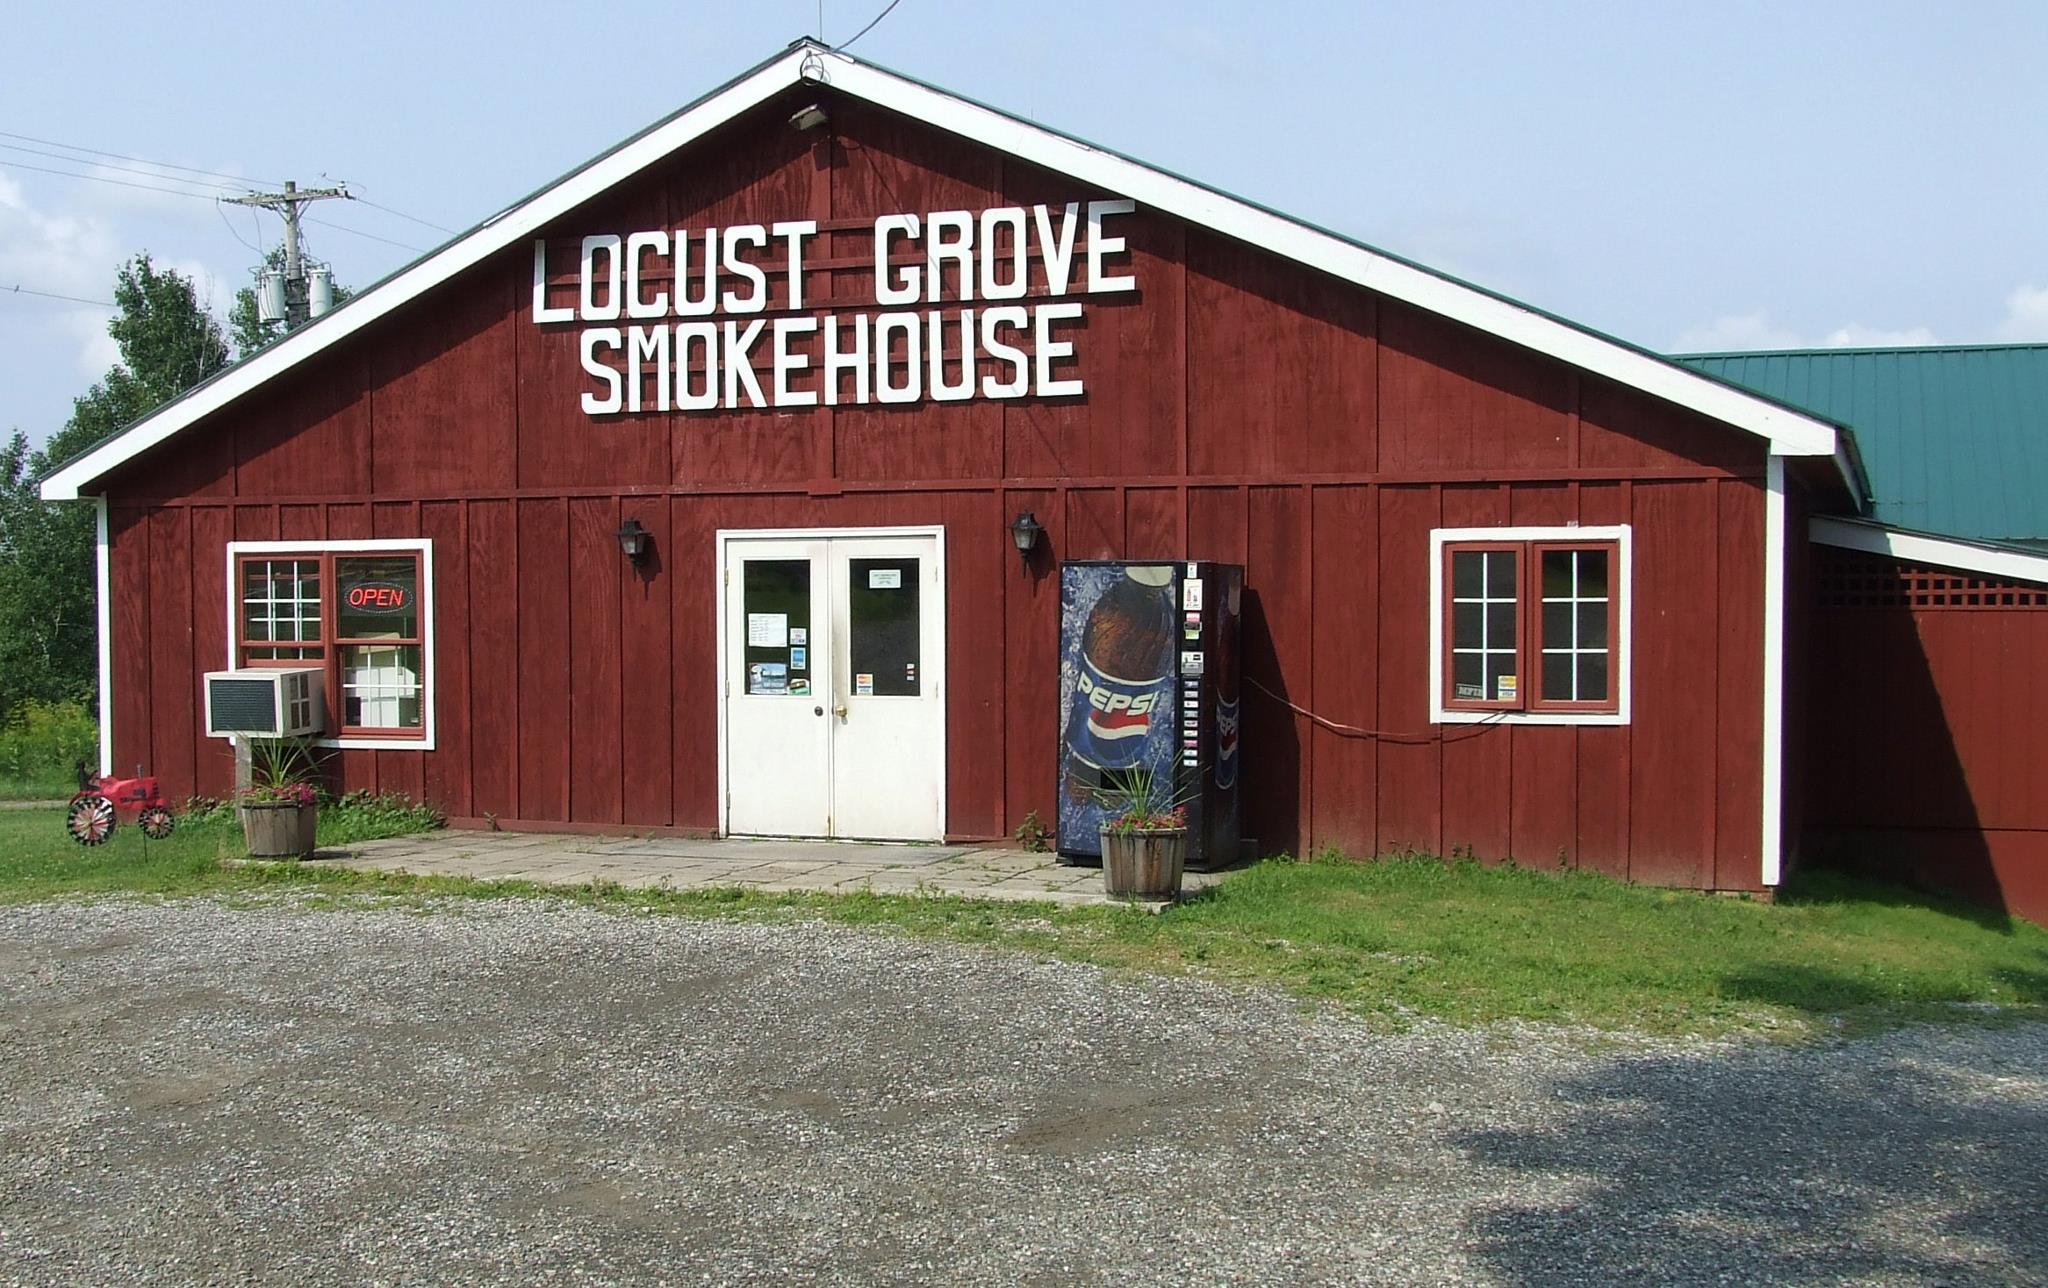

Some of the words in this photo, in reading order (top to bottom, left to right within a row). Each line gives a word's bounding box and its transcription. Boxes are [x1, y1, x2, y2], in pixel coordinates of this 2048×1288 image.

[533, 220, 817, 324] LOCUST
[874, 201, 1136, 306] GROVE
[580, 303, 1083, 415] SMOKEHOUSE
[349, 588, 404, 606] OPEN
[1077, 671, 1159, 716] PEPSI
